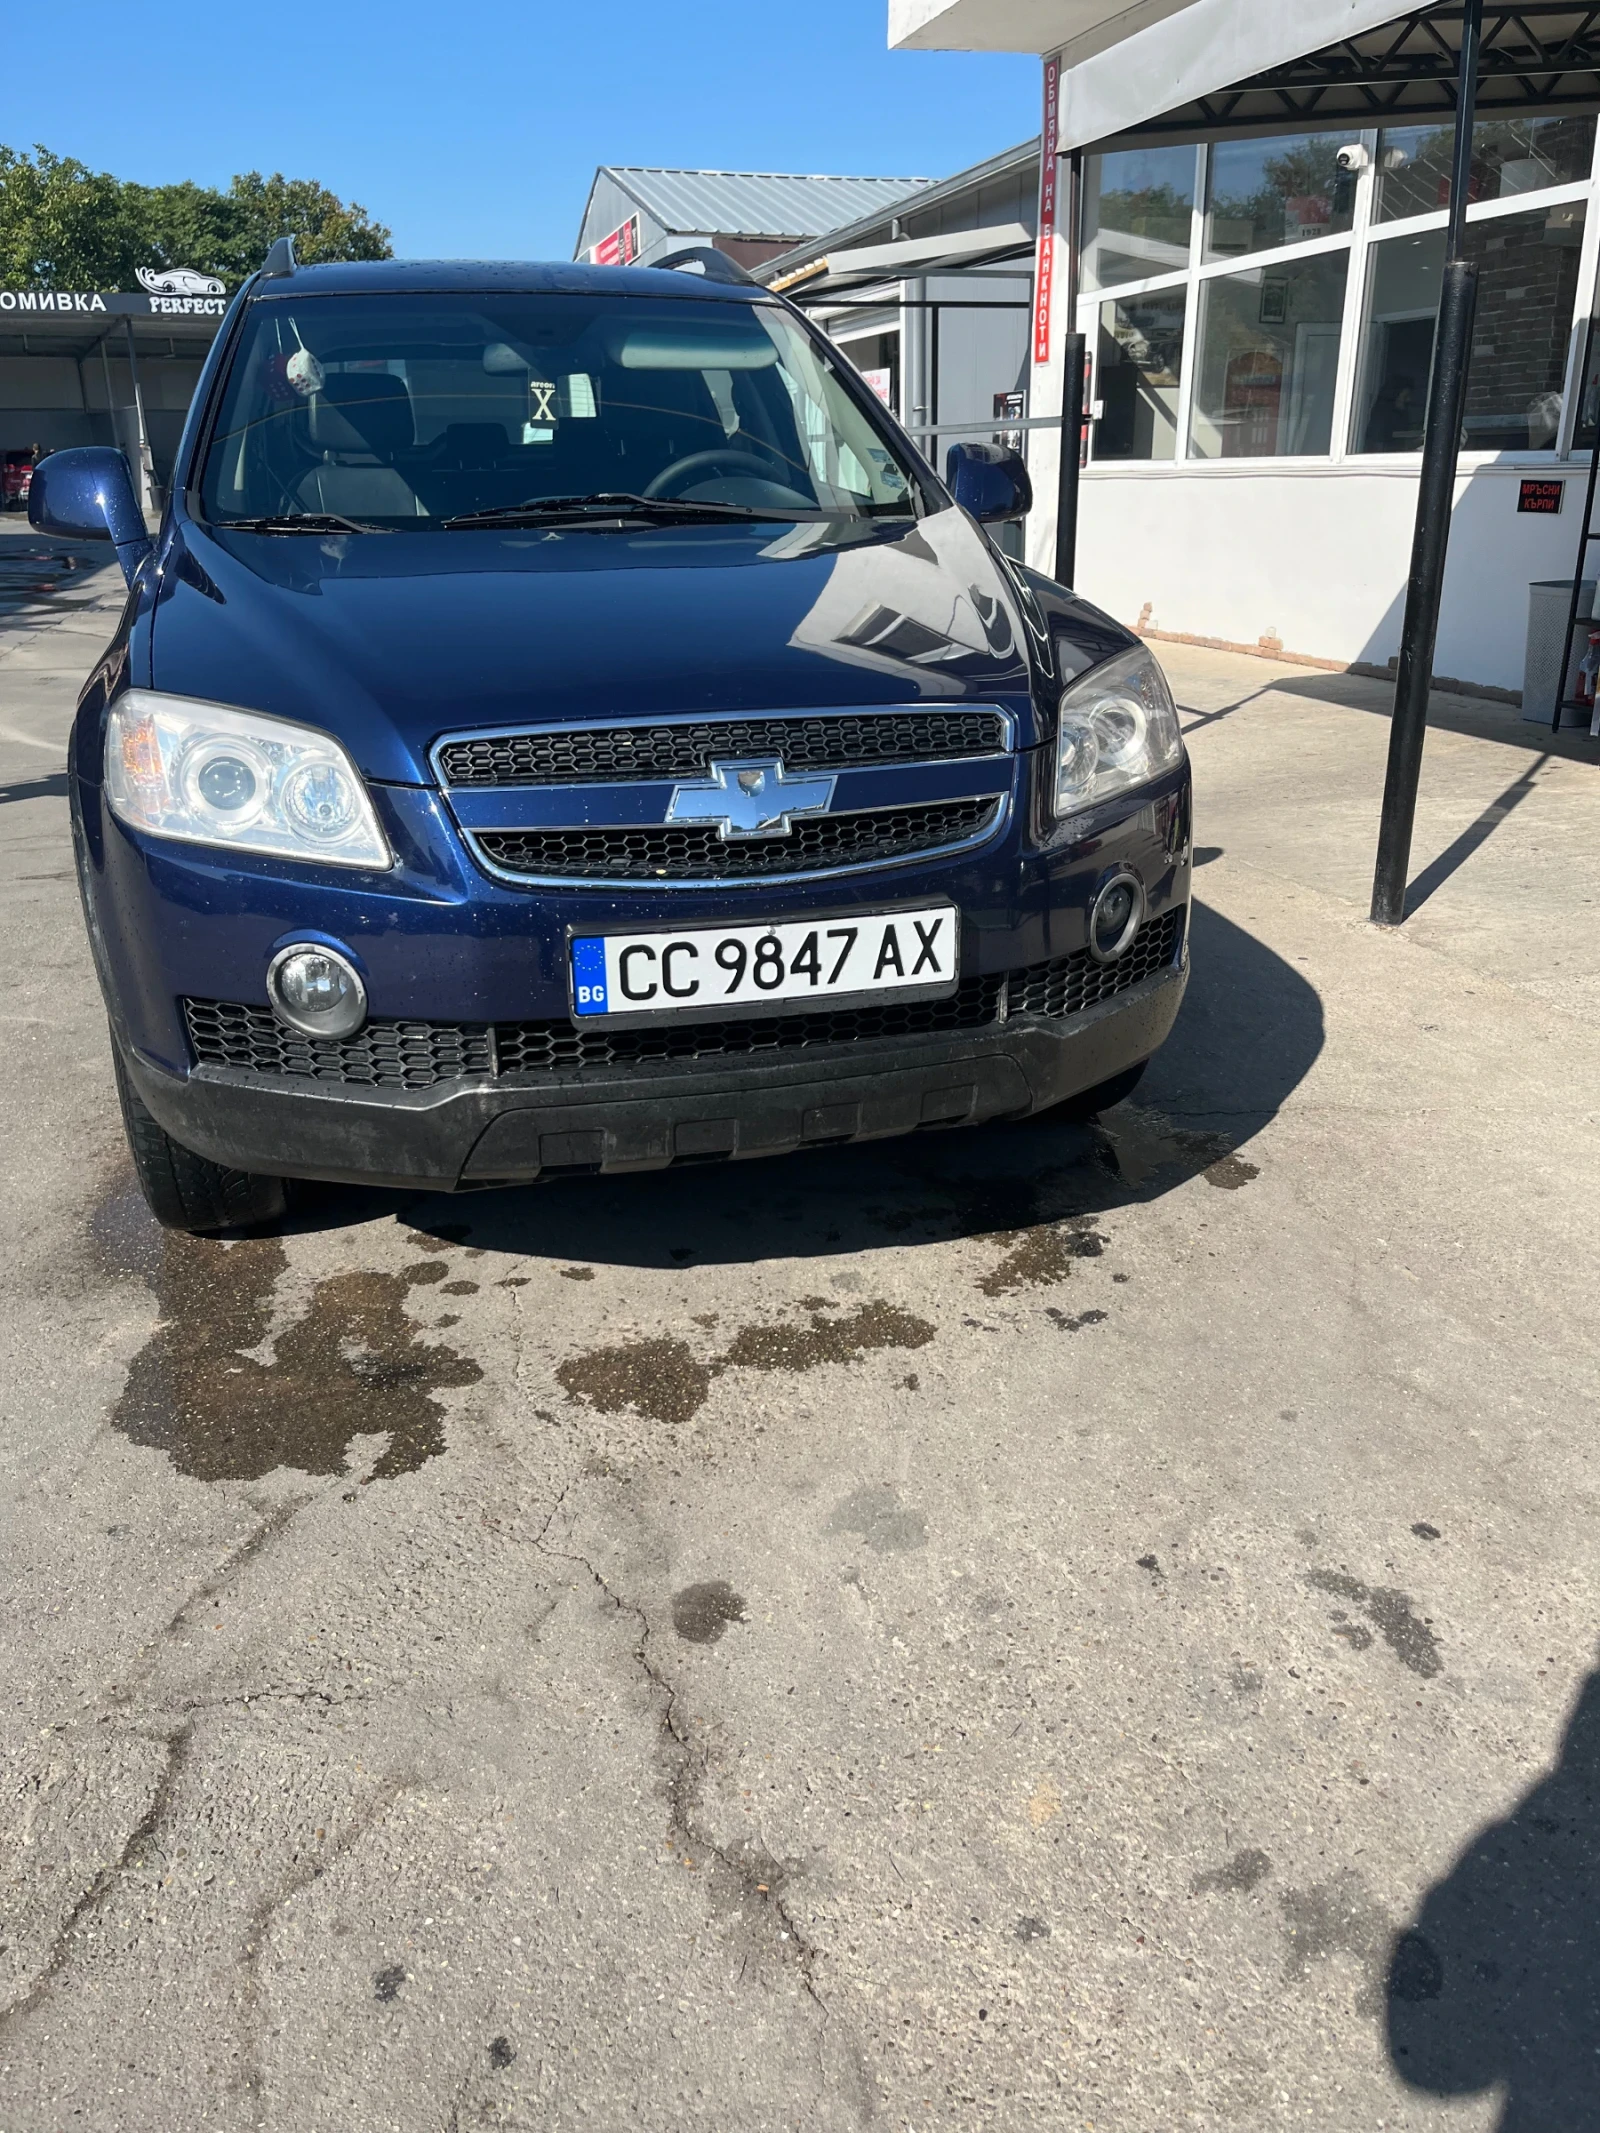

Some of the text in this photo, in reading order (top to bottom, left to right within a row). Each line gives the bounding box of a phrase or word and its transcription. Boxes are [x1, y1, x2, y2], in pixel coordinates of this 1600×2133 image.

[1038, 66, 1056, 358] ОБМЯНА НА БАНКНОТИ
[149, 296, 226, 315] PERFECT
[531, 389, 556, 420] X
[1522, 484, 1560, 495] МРЪСНИ
[1524, 498, 1555, 509] КЪРПИ
[619, 917, 943, 1001] CC 9847 AX
[578, 985, 605, 1003] BG
